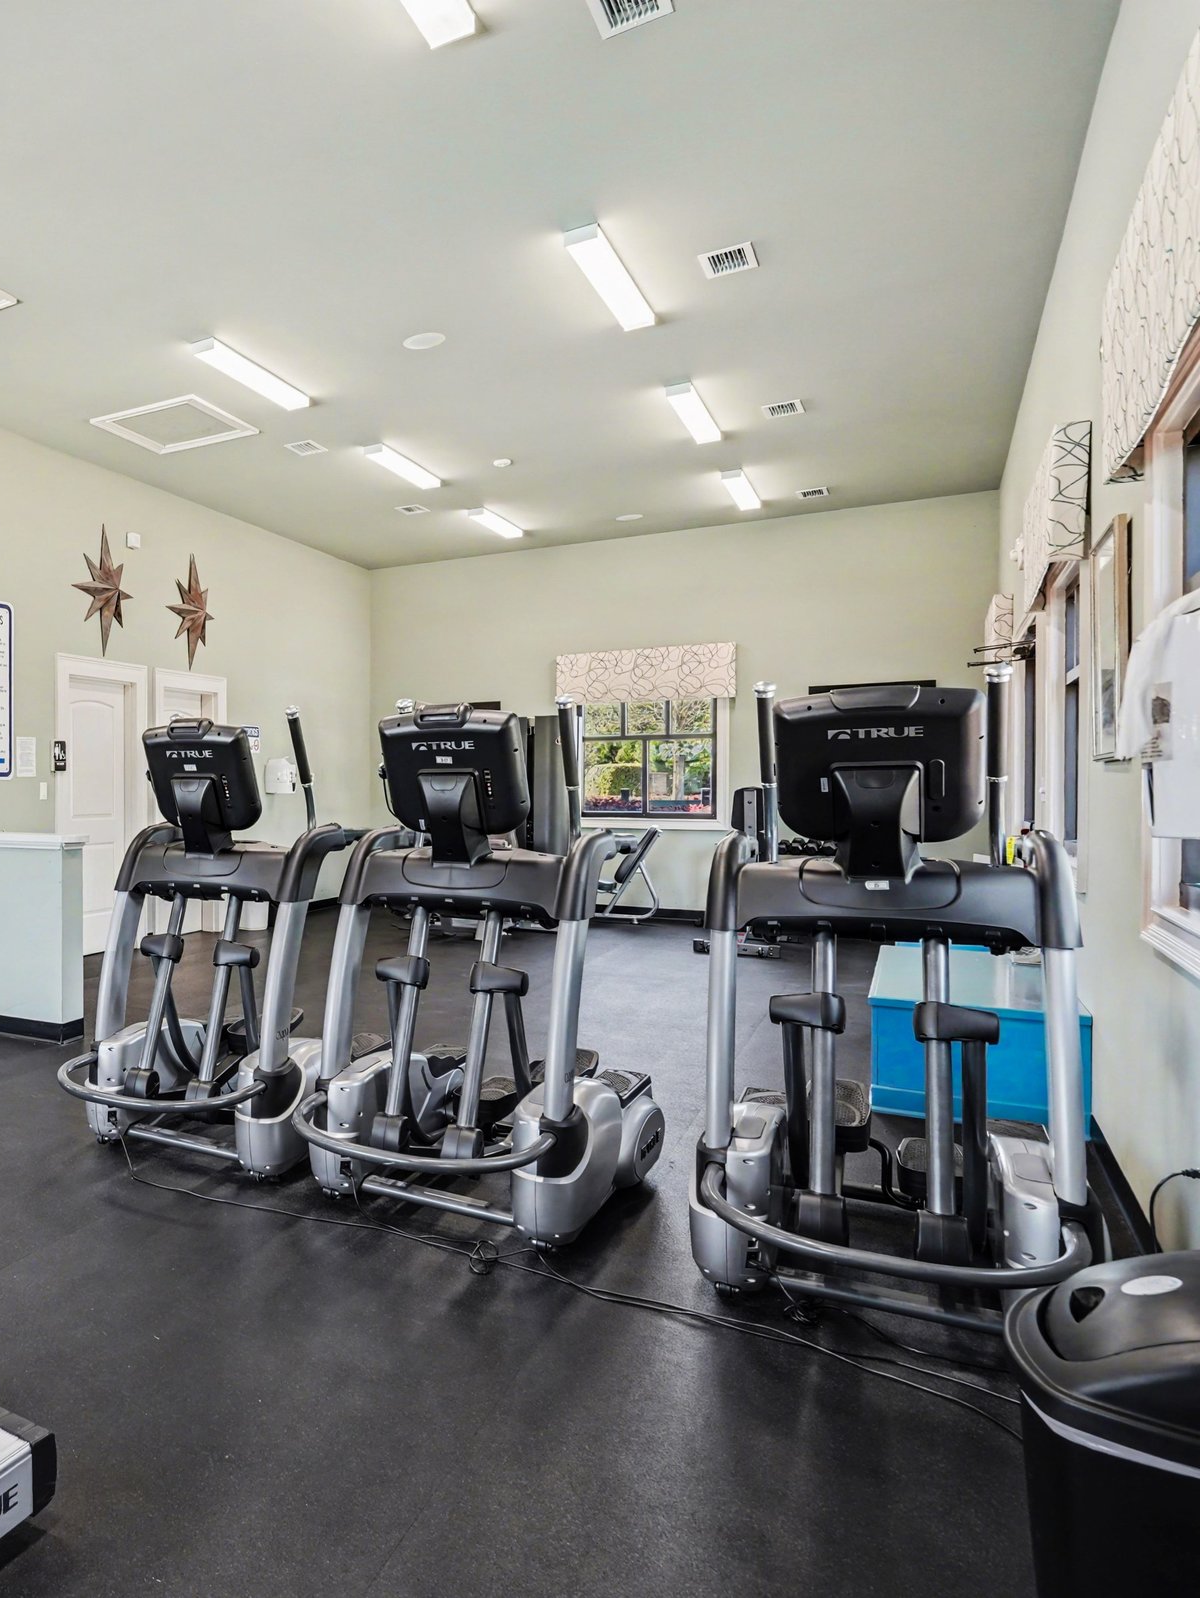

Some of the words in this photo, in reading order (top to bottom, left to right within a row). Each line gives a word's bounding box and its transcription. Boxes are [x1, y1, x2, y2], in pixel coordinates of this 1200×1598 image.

[853, 726, 924, 739] TRUE
[427, 740, 475, 751] TRUE
[178, 750, 213, 758] TRUE
